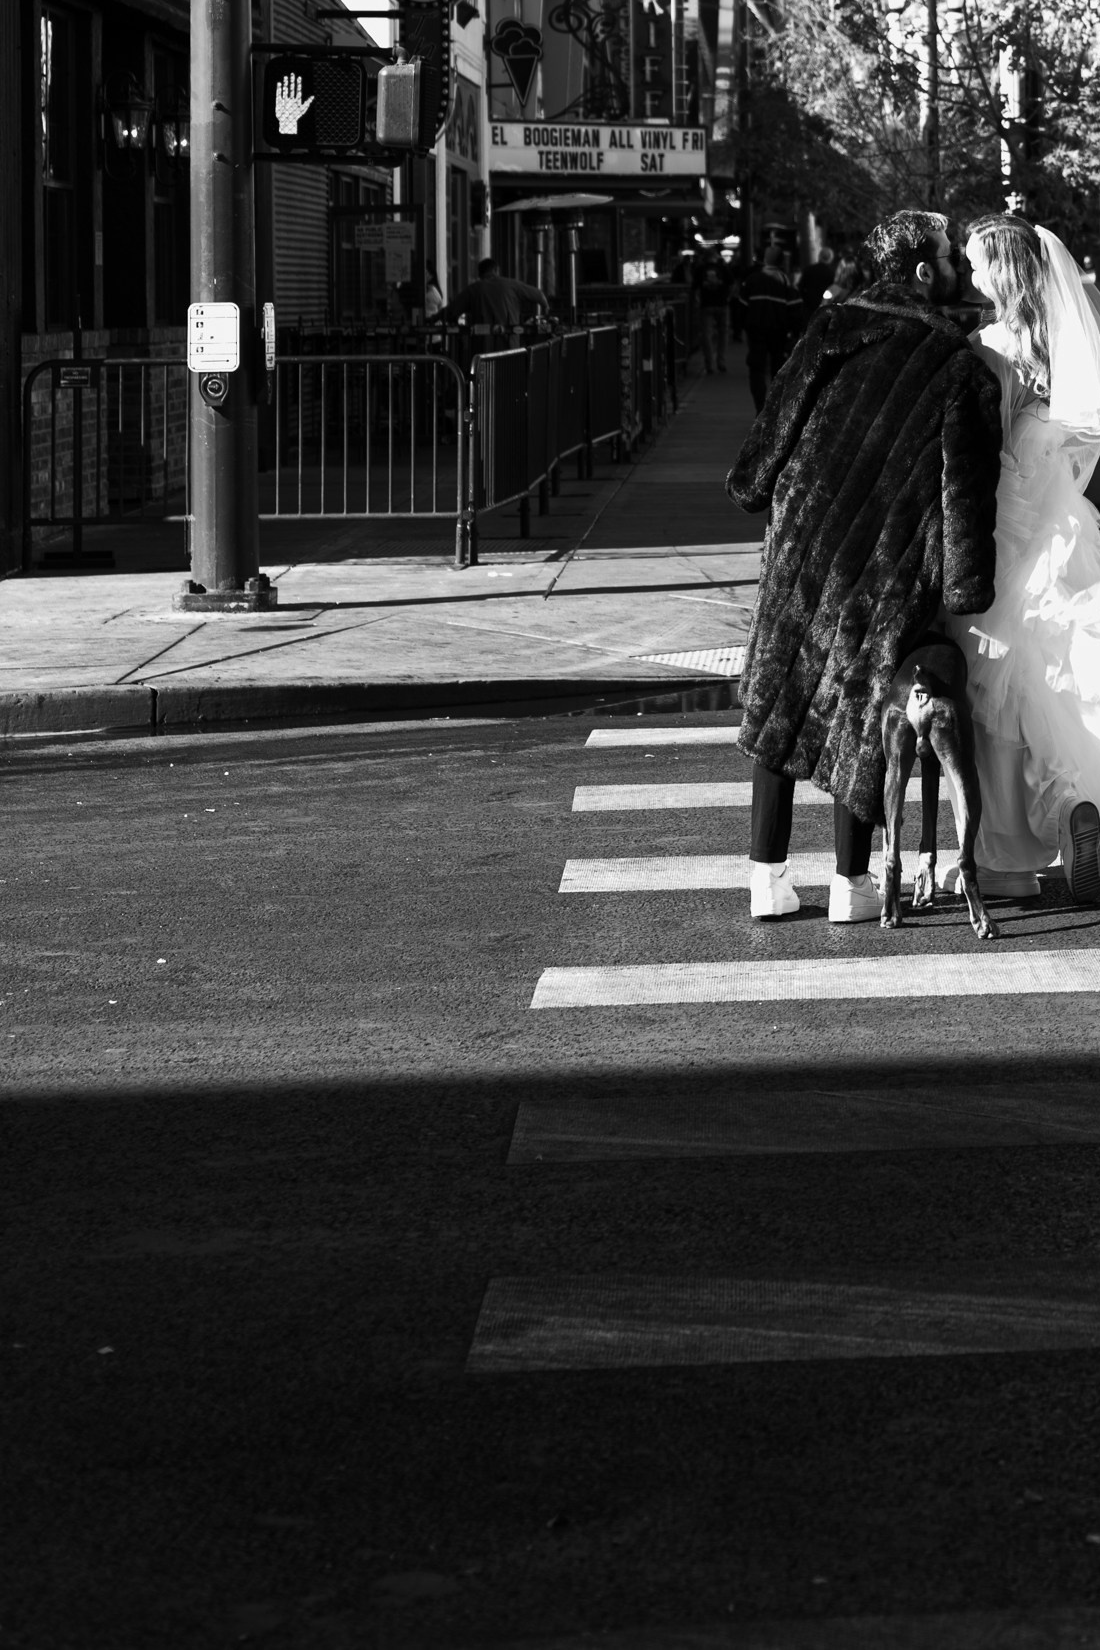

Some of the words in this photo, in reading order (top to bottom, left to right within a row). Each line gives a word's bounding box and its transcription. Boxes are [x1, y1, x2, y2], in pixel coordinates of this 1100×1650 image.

[491, 126, 508, 146] EL
[524, 127, 600, 148] BOOGIEMAN
[609, 129, 634, 149] ALL
[640, 131, 676, 150] VINYL
[682, 131, 704, 151] FRI
[538, 151, 604, 171] TEENWOLF
[641, 153, 665, 172] SAT
